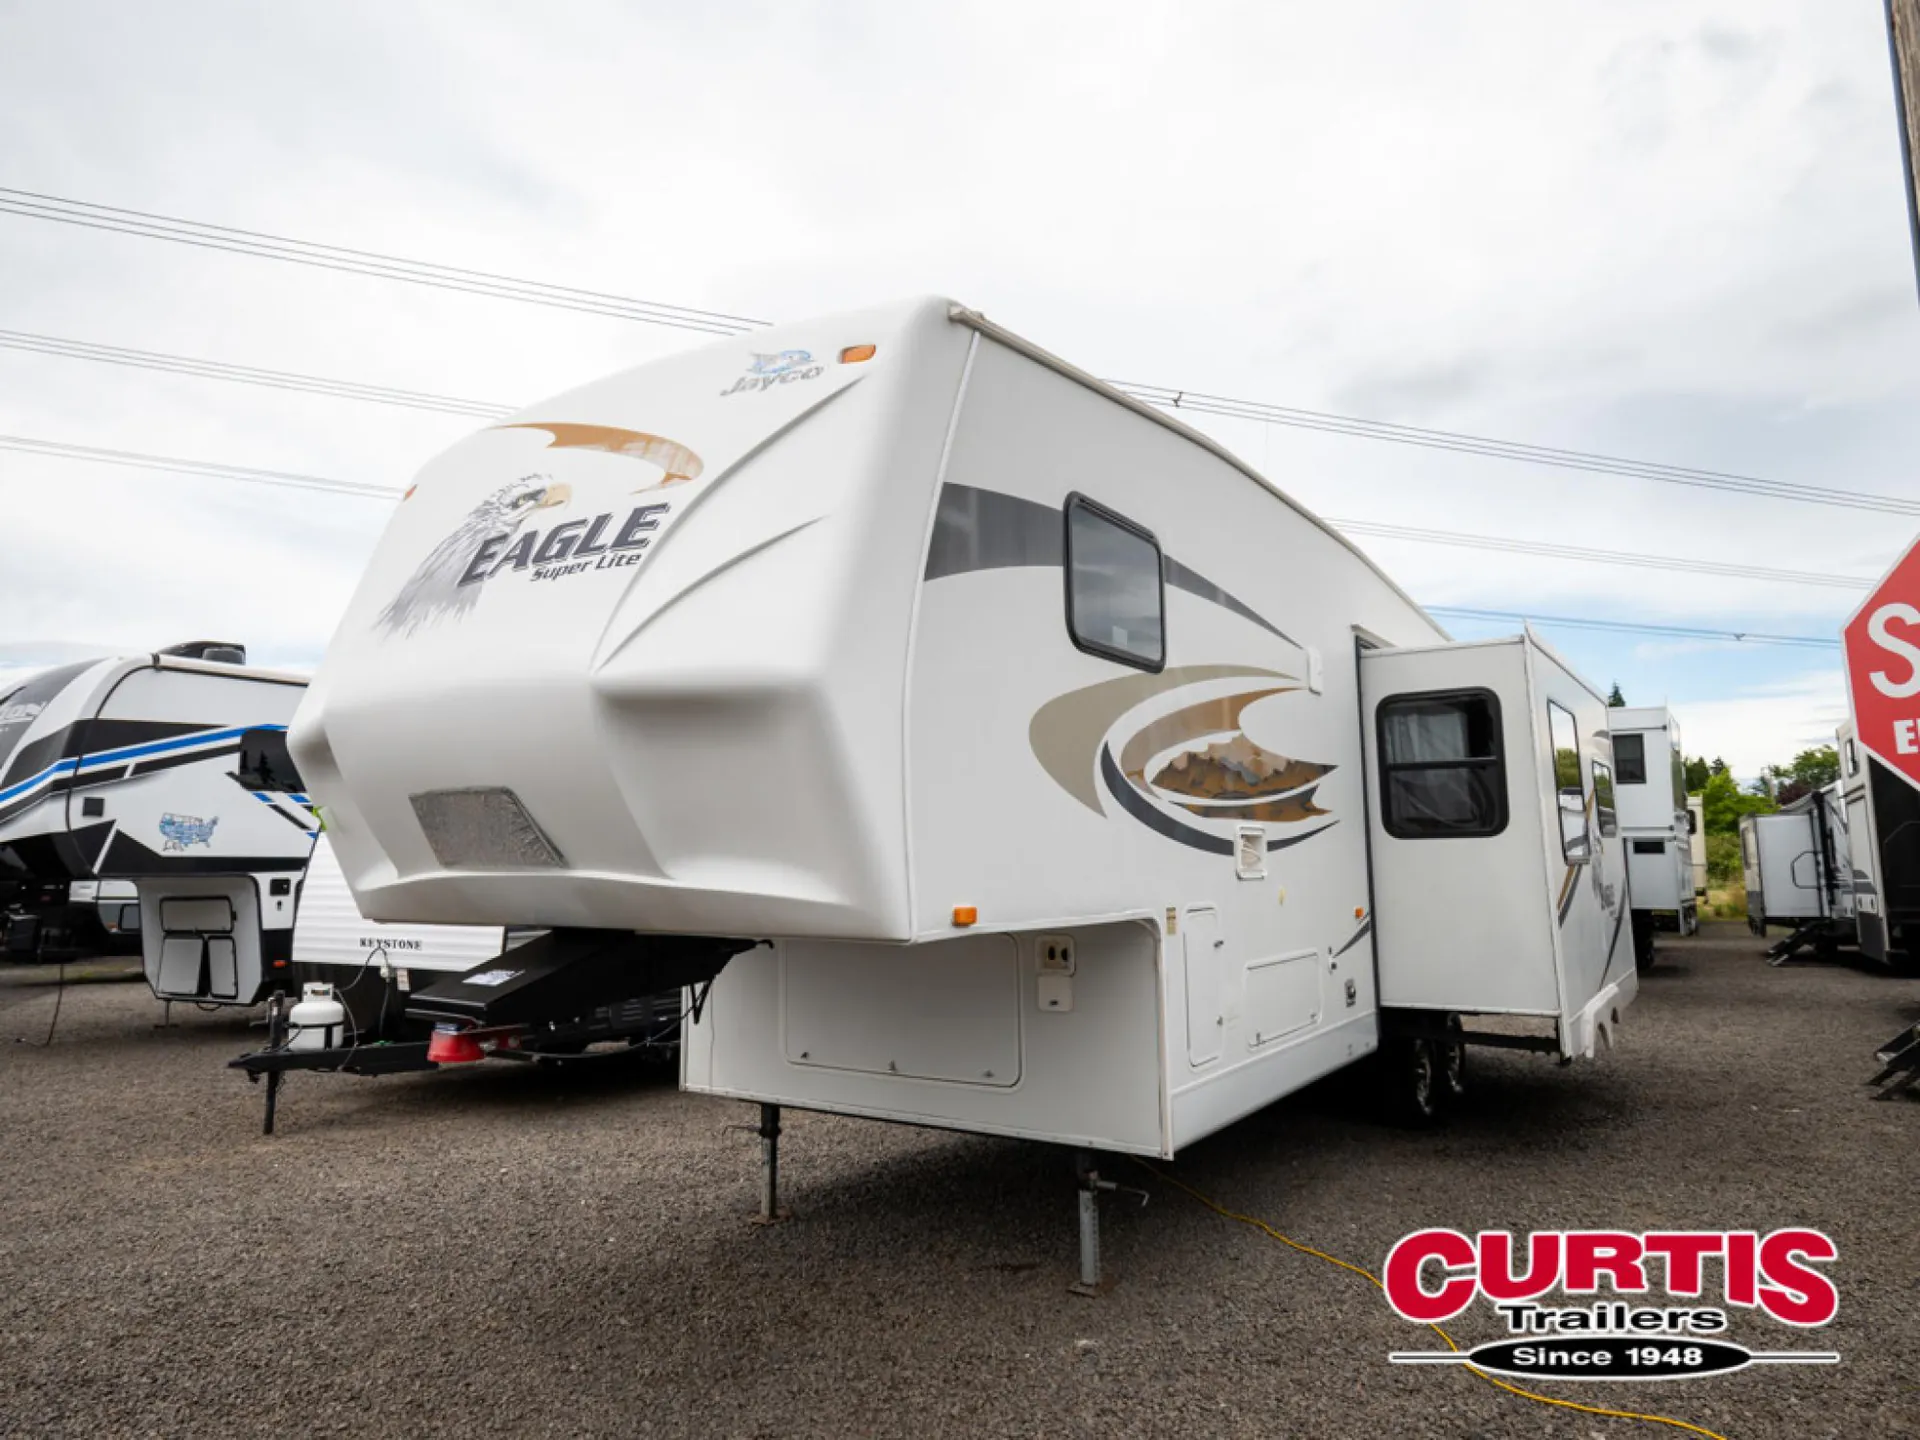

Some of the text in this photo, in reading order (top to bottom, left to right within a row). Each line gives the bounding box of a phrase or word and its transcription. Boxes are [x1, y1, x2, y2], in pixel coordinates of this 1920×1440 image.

[719, 365, 825, 396] Jayco
[456, 502, 672, 588] EAGLE
[529, 552, 642, 582] Super Lite
[359, 937, 423, 950] KEYSTONE
